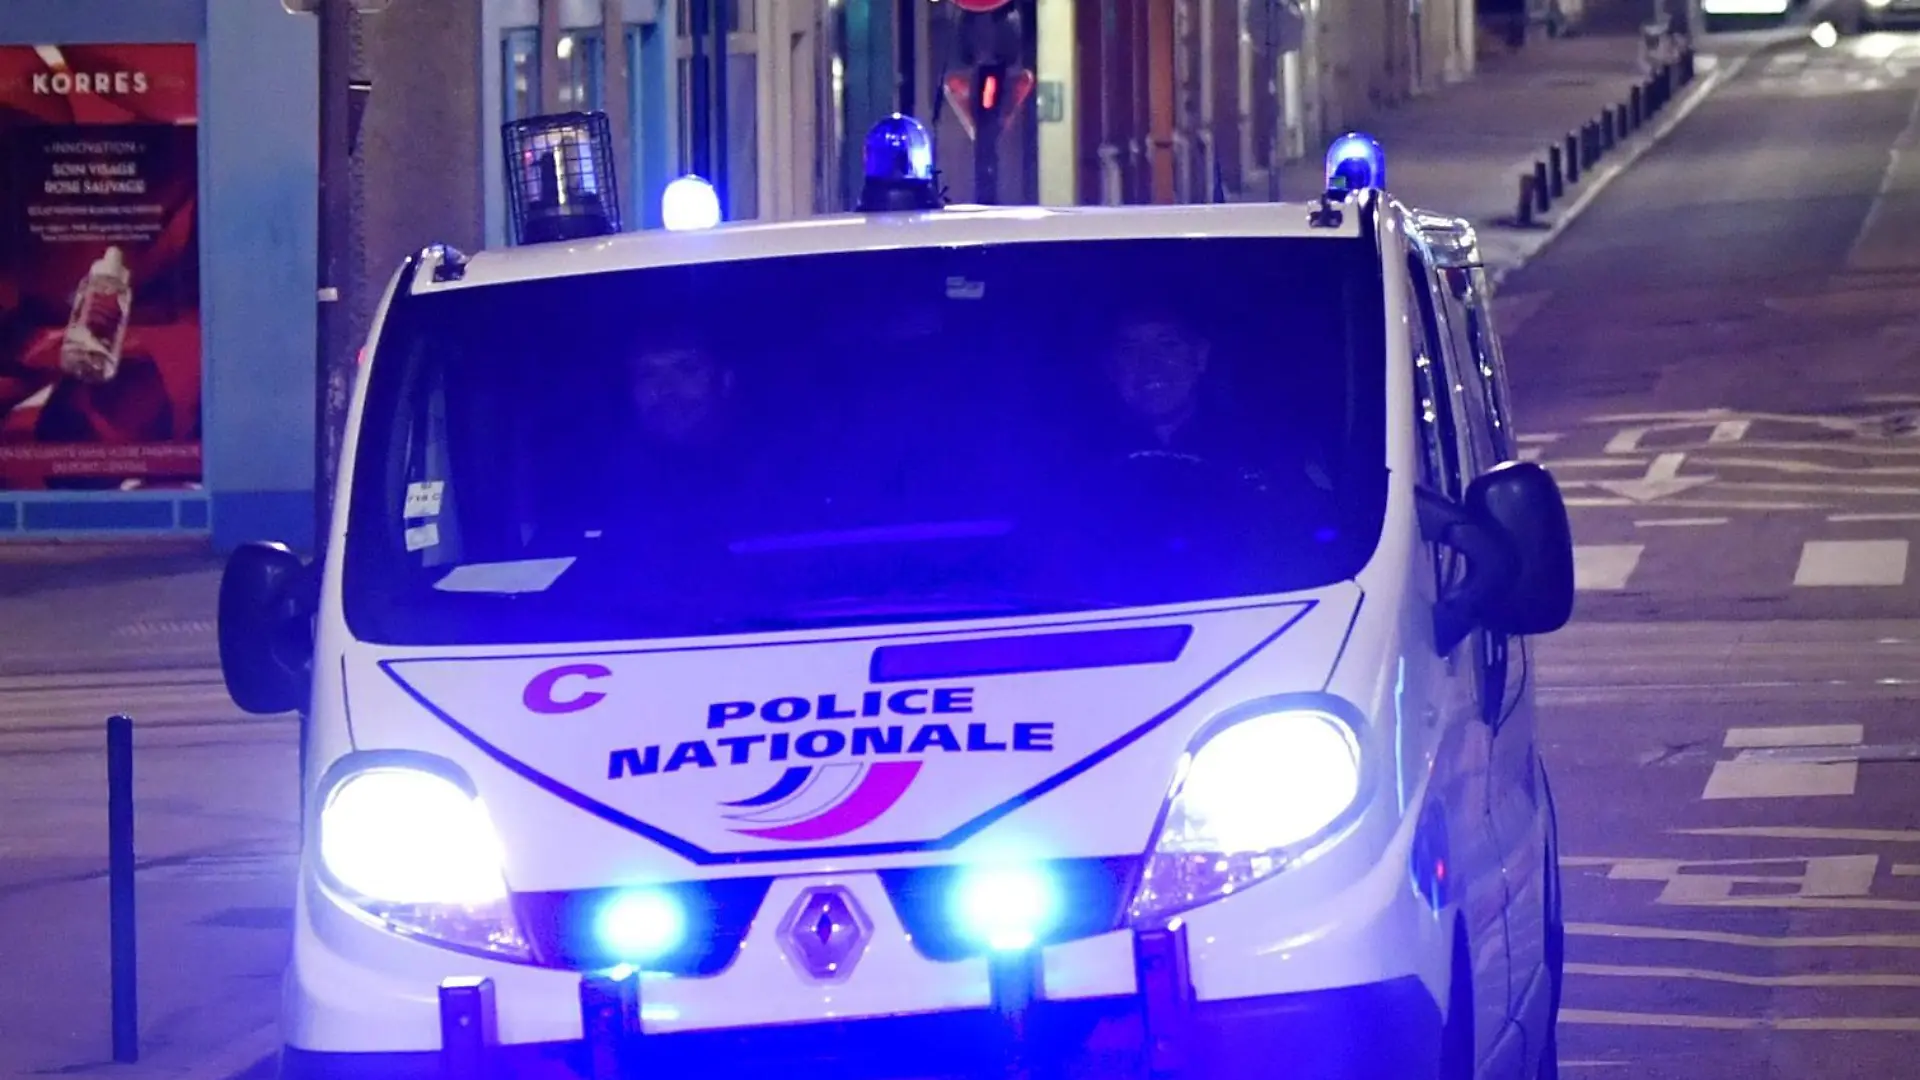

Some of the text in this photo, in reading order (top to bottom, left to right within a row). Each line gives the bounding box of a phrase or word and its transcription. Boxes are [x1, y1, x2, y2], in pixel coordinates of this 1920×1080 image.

[33, 72, 148, 94] KORRES
[52, 162, 136, 176] SOIN VISAGE
[84, 179, 145, 194] SAUVAGE
[522, 664, 612, 714] C
[707, 687, 974, 729] POLICE
[608, 721, 1054, 779] NATIONALE
